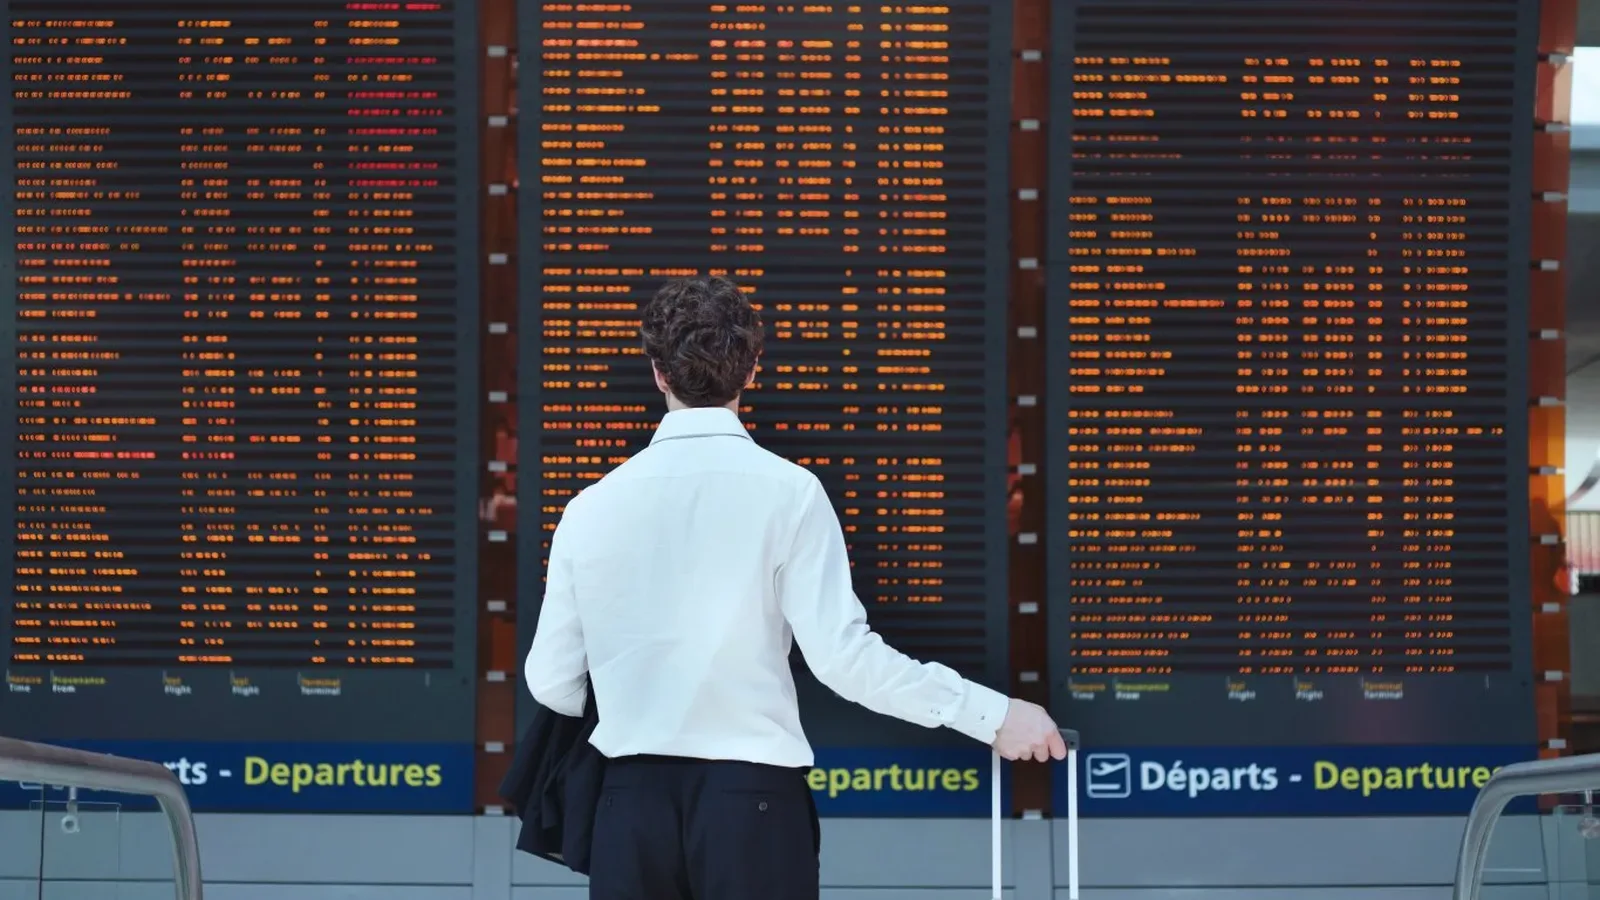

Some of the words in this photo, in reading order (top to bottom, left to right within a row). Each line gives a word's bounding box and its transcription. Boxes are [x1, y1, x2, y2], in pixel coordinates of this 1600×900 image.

[9, 684, 31, 693] Time
[52, 684, 76, 693] From
[164, 685, 192, 696] Flight
[232, 685, 259, 696] Flight
[301, 686, 341, 696] Terminal
[244, 756, 442, 792] Departures
[1140, 760, 1279, 798] Départs
[1313, 761, 1503, 797] Departure
[806, 764, 980, 798] epartures
